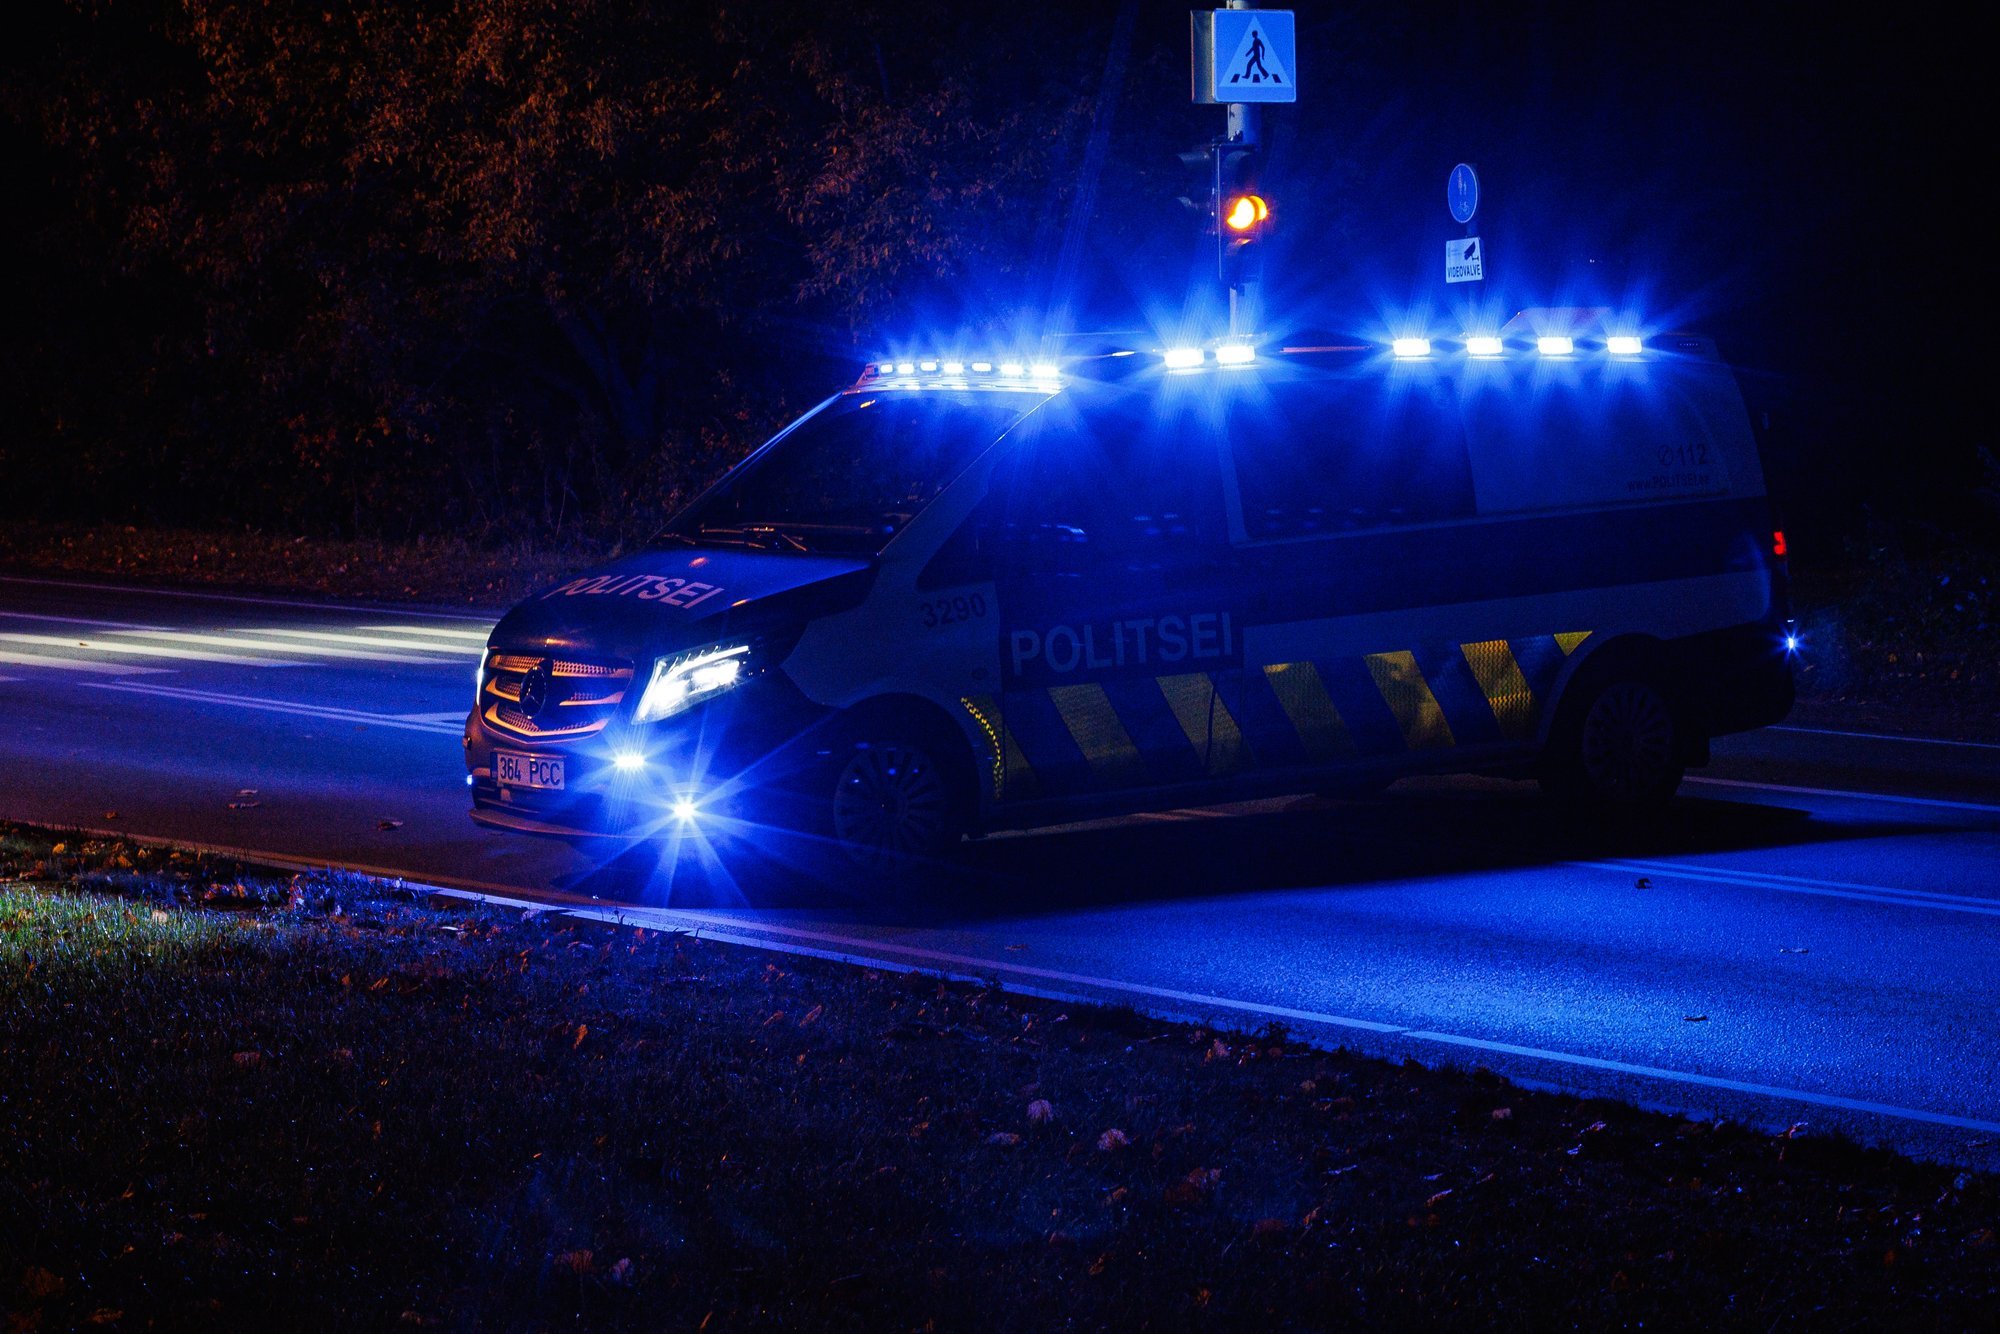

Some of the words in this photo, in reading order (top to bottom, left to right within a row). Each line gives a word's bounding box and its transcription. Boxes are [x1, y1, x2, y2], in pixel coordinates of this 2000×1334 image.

[1447, 263, 1481, 278] VIDEOVALVE
[1676, 443, 1707, 467] 112
[920, 593, 986, 629] 3290
[1010, 611, 1233, 676] POLITSEI
[500, 757, 521, 782] 364
[529, 760, 560, 785] PCC
